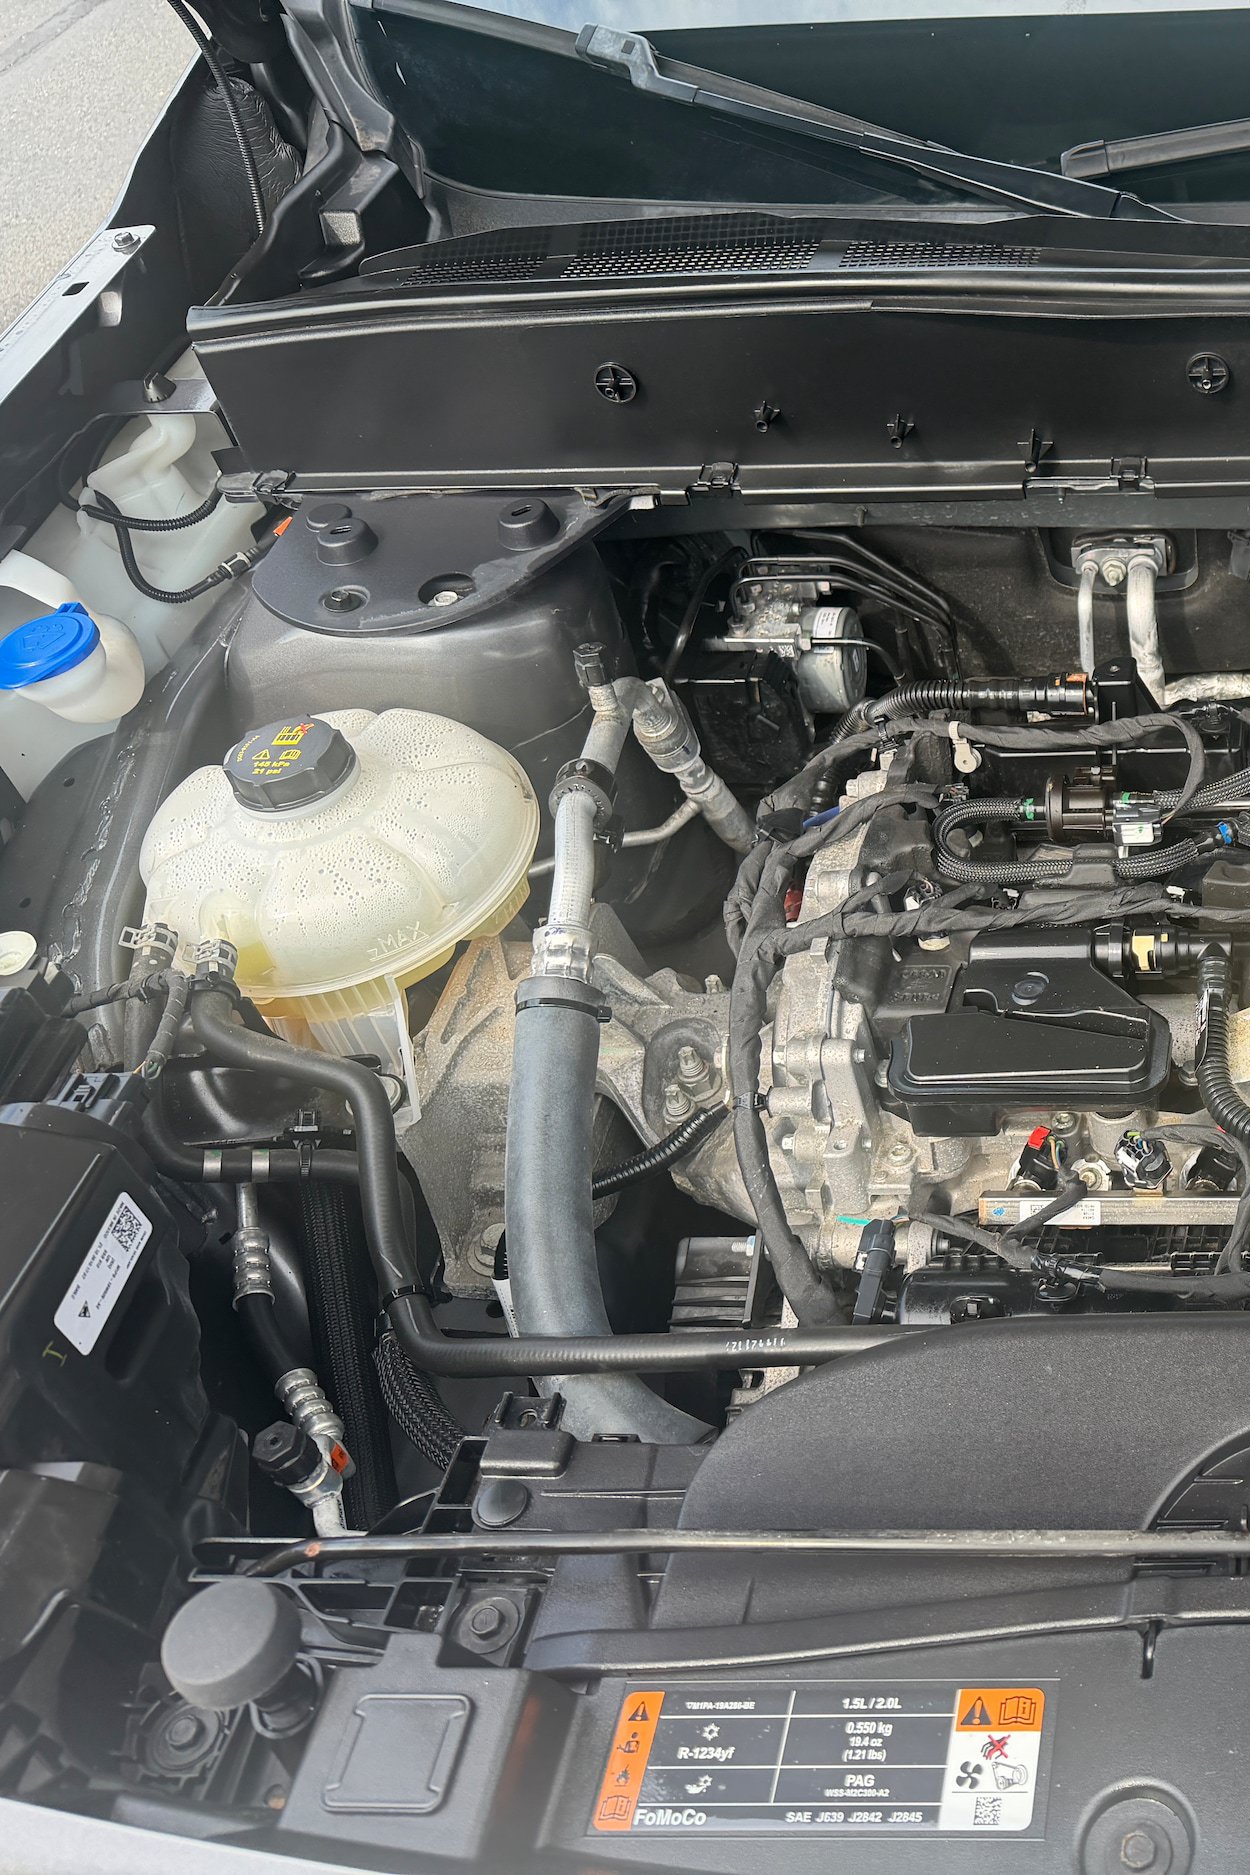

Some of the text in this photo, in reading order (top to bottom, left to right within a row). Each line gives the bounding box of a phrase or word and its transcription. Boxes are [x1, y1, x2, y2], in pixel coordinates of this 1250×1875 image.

[377, 920, 430, 953] MAX
[842, 1697, 868, 1709] 1.5L
[875, 1697, 902, 1709] 2.0L
[845, 1721, 893, 1736] 0.550 kg
[849, 1737, 883, 1747] 19.4 oz
[677, 1746, 736, 1761] R-1234yf
[842, 1749, 887, 1762] (1.21 lbs)
[844, 1774, 875, 1787] PAG
[633, 1808, 923, 1826] FoMoCo SAE J639 J2842 J2845
